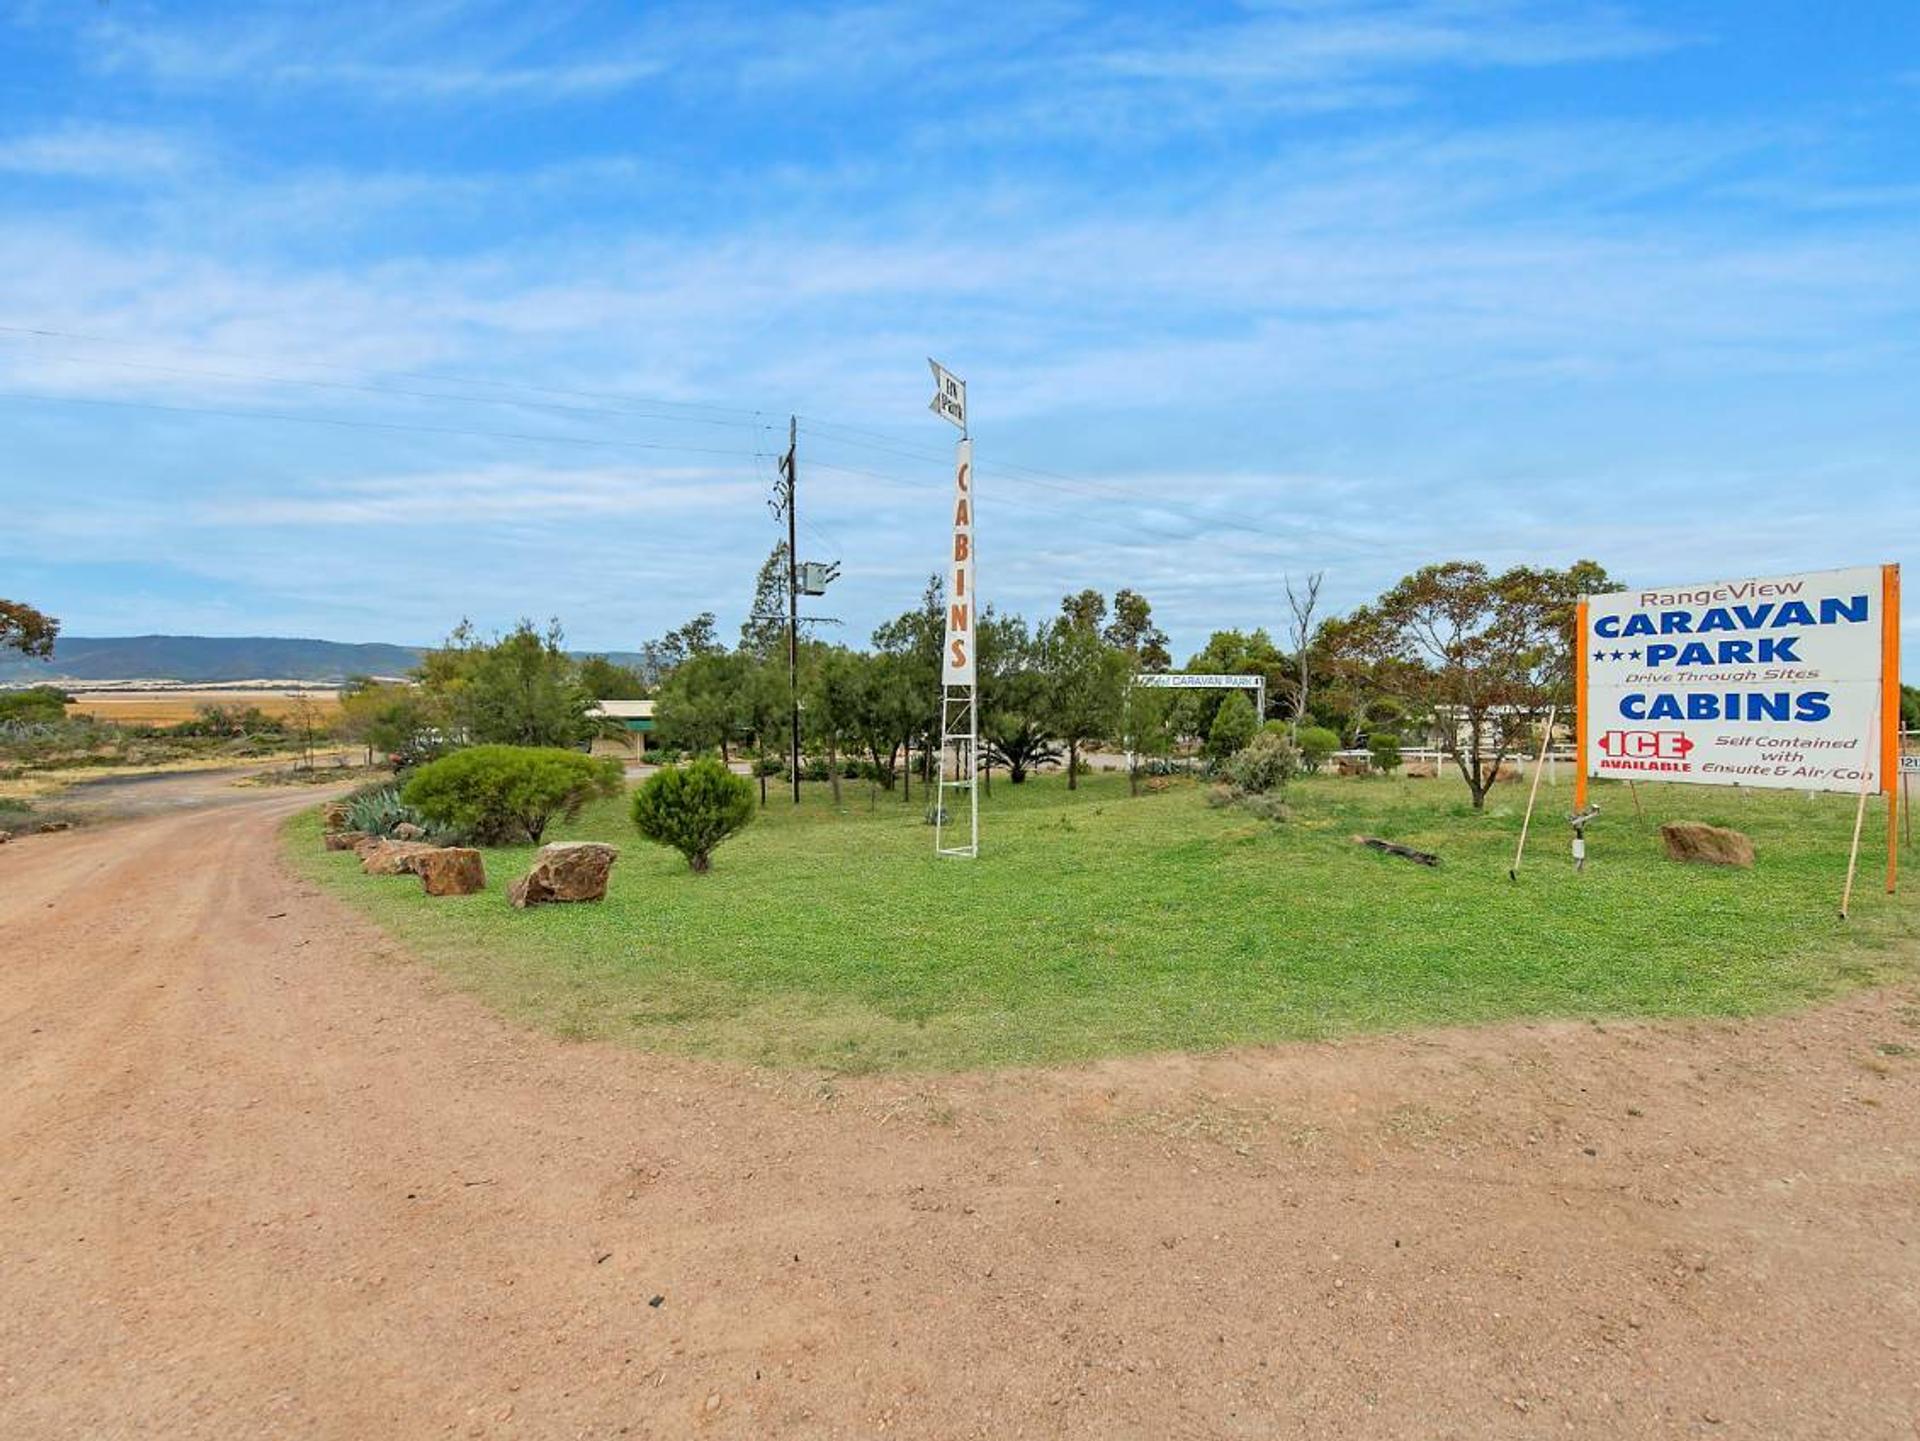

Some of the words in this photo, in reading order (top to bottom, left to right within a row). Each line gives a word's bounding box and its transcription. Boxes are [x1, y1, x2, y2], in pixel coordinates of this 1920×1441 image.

[951, 463, 969, 668] CABINS
[1641, 581, 1804, 607] RangeView
[1594, 595, 1869, 638] CARAVAN
[1646, 637, 1802, 667] PARK
[1172, 676, 1223, 686] CARAVAN
[1625, 671, 1673, 683] Drive
[1678, 669, 1757, 683] Through
[1763, 668, 1820, 681] Sites
[1619, 691, 1831, 721] CABINS
[1605, 731, 1686, 759] ICE
[1715, 735, 1754, 747] Self
[1755, 736, 1858, 749] Contained
[1600, 759, 1692, 773] AVAILABLE
[1761, 750, 1804, 763] with
[1702, 762, 1770, 776] Ensuite
[1774, 767, 1790, 777] &
